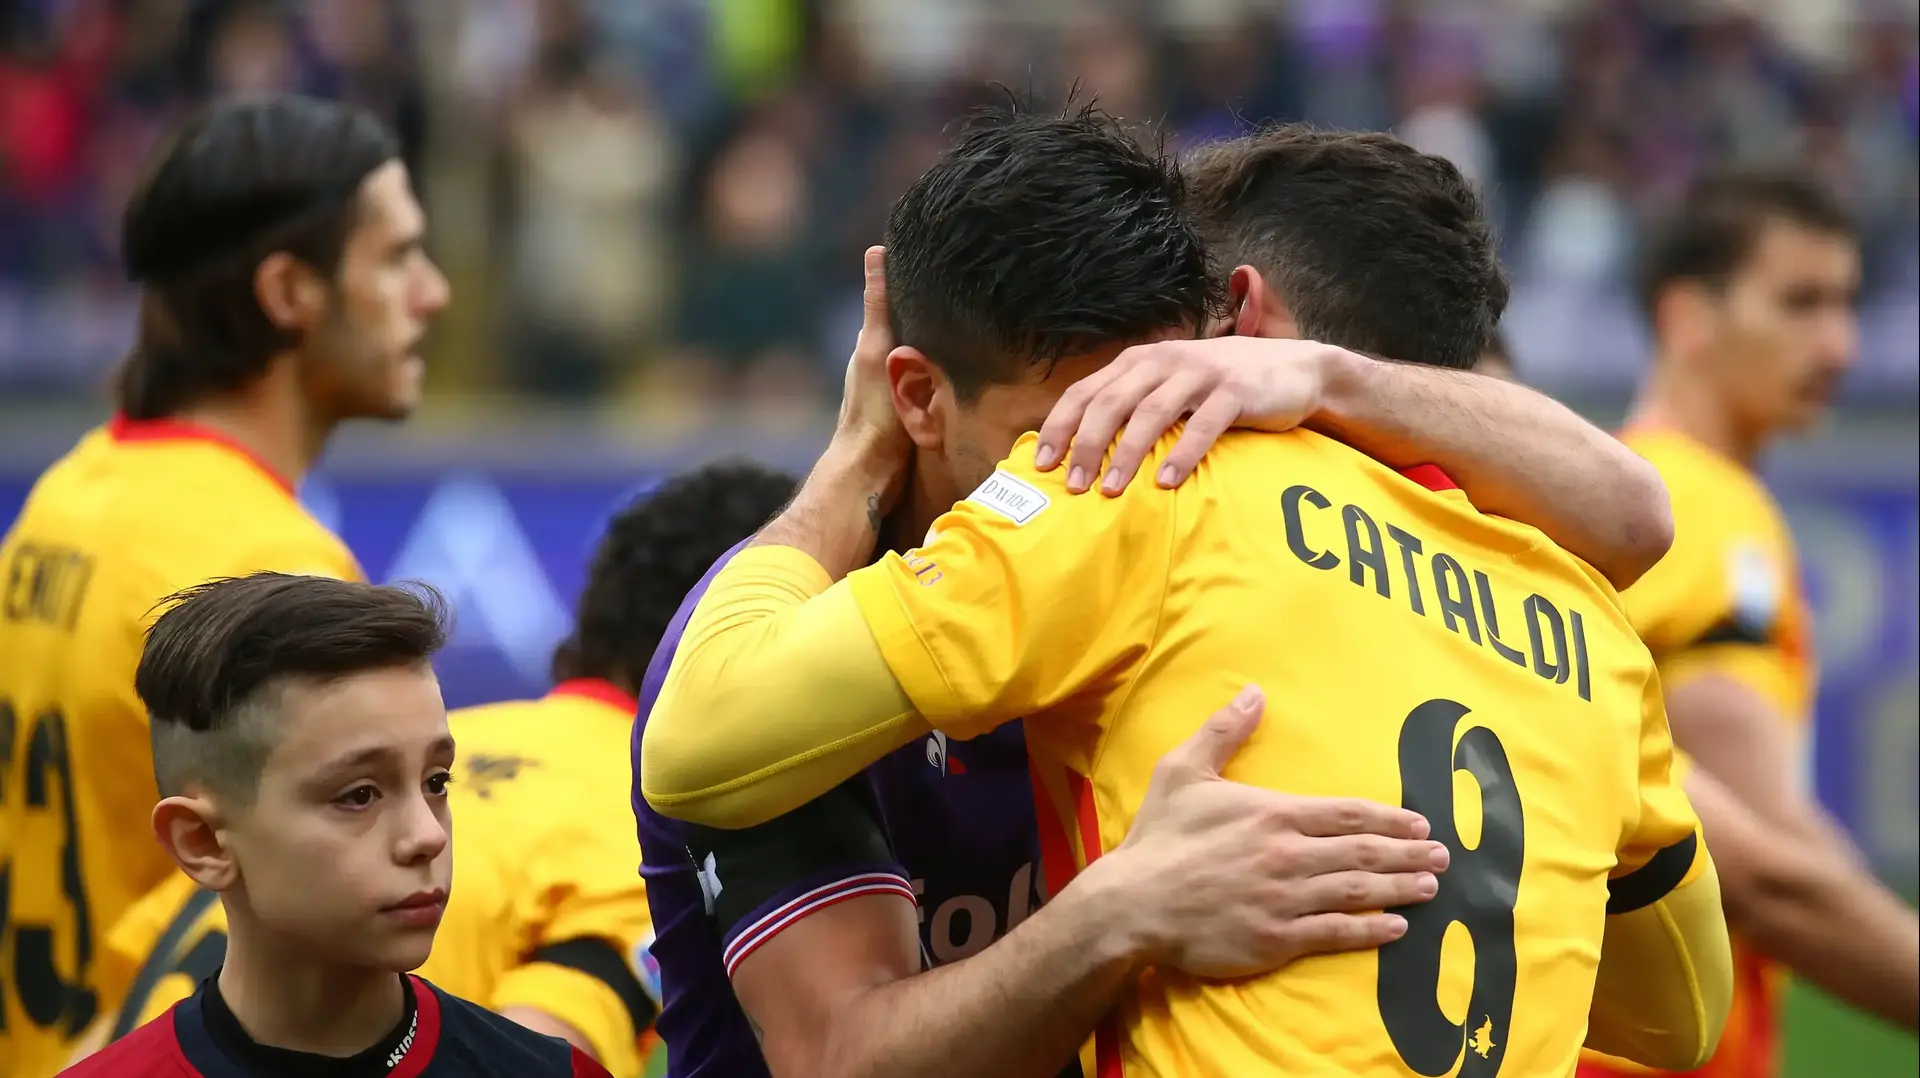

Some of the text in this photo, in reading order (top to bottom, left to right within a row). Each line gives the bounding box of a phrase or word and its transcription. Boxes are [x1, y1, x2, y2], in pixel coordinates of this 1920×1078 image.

[982, 479, 1030, 513] DAVIDE
[1281, 484, 1591, 703] CATALDI
[1377, 698, 1525, 1078] 8
